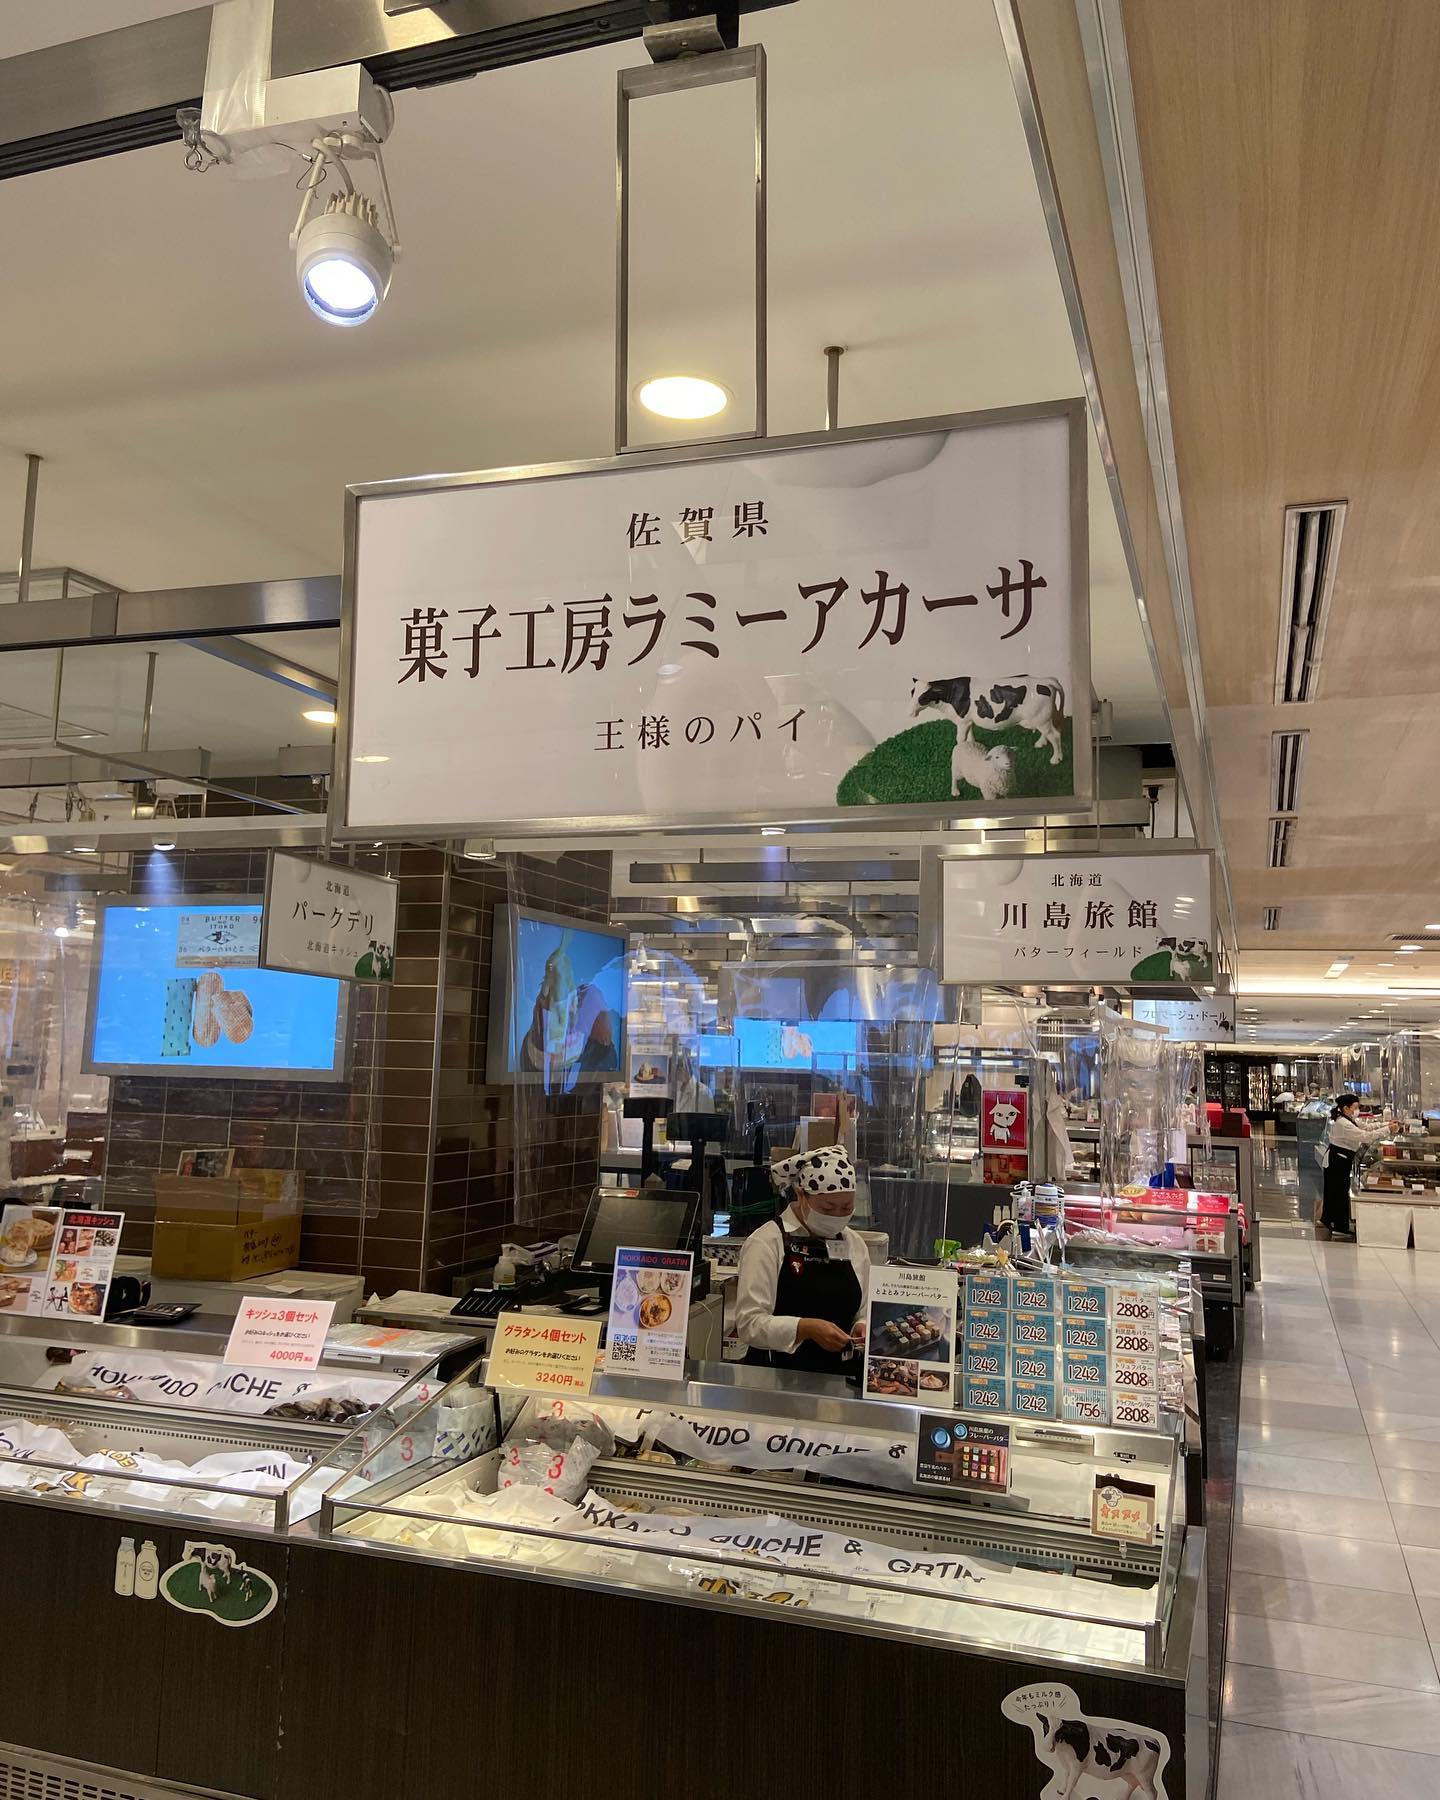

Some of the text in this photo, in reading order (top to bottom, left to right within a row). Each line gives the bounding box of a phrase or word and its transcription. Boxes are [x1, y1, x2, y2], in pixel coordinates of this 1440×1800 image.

[626, 501, 769, 549] 佐賀県
[397, 559, 1048, 685] 菓子工房ラミーアカーサ
[593, 708, 808, 752] 王様のパイ
[1051, 872, 1103, 887] 北海道
[325, 880, 350, 897] 北海道
[292, 900, 374, 936] パークデリ
[1000, 900, 1158, 930] 川島旅館
[306, 939, 359, 959] 北海道キッシュ
[1013, 946, 1142, 959] バターフィールド
[621, 1253, 689, 1267] HOKKAIDO GRATIN
[972, 1288, 1001, 1305] 1242
[1016, 1291, 1047, 1307] 1242
[1067, 1296, 1099, 1312] 1242
[245, 1308, 319, 1324] キッシュ3個セット
[504, 1325, 588, 1344] グラタン4個セット
[970, 1323, 1000, 1339] 1242
[1016, 1325, 1047, 1341] 1242
[1066, 1330, 1097, 1346] 1242
[968, 1355, 998, 1372] 1242
[1015, 1360, 1046, 1377] 1242
[535, 1372, 574, 1386] 3240円
[1068, 1365, 1099, 1381] 1242
[969, 1390, 999, 1406] 1242
[1016, 1394, 1047, 1411] 1242
[548, 1455, 564, 1479] 3
[1100, 1503, 1141, 1523] オススメ
[843, 1539, 864, 1557] &
